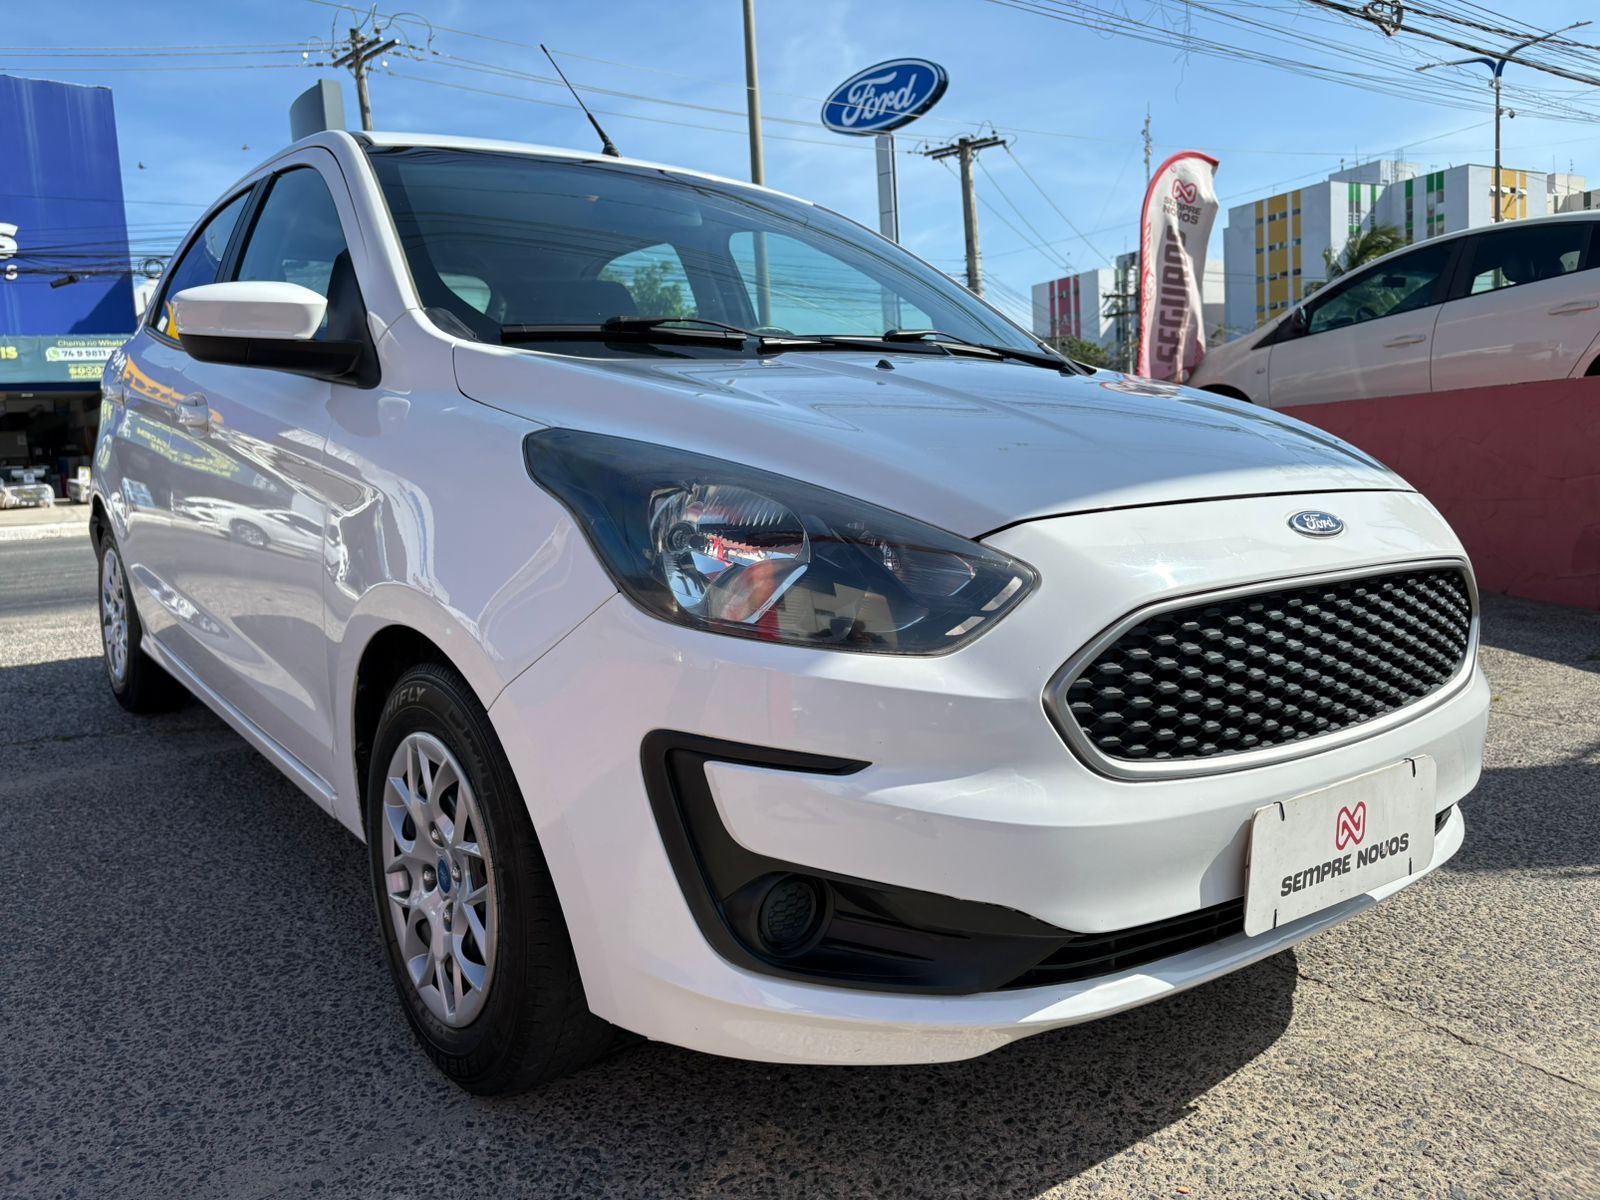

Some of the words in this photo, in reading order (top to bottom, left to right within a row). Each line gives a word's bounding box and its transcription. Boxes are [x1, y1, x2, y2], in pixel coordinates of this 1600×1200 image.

[841, 71, 917, 126] Ford
[1162, 204, 1199, 225] NOVOS
[1163, 196, 1202, 215] SEMPRE
[0, 346, 18, 359] IS
[1302, 513, 1336, 530] Ford
[1280, 853, 1352, 897] SEMPRE
[1356, 832, 1409, 869] NOVOS
